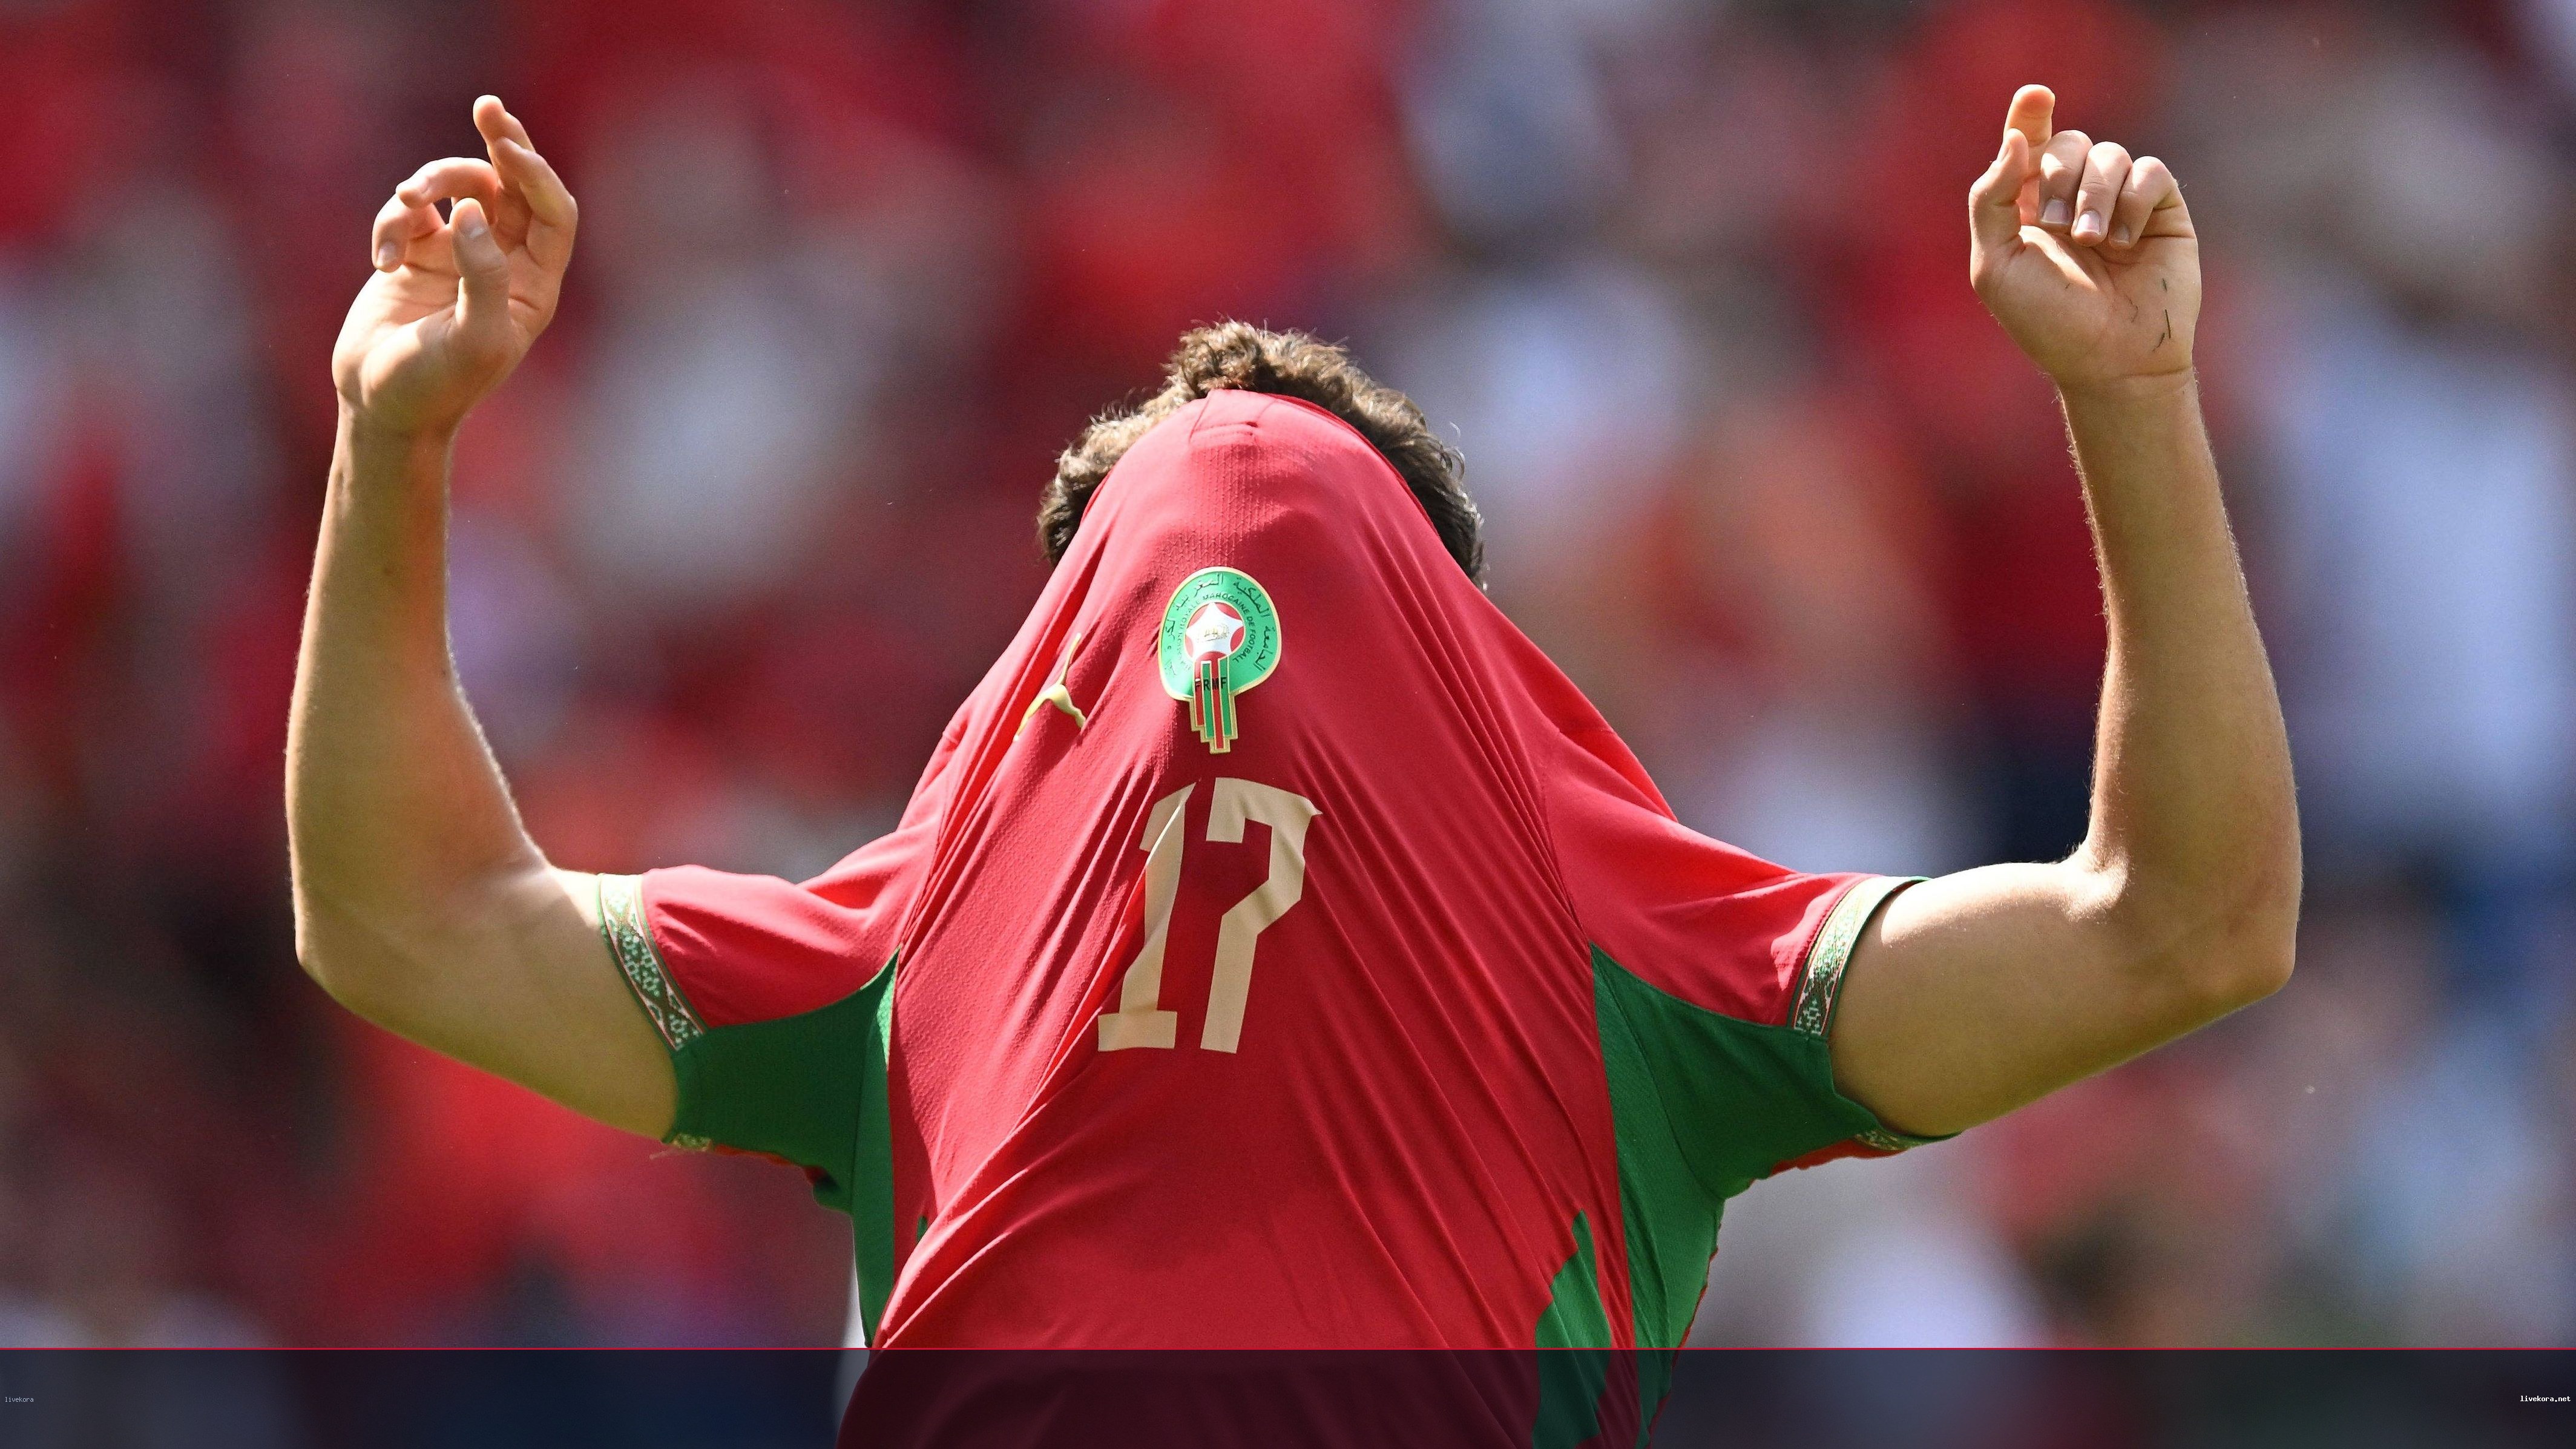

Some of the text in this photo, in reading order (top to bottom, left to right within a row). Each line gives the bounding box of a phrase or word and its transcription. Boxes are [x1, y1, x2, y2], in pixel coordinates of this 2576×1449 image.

[1233, 577, 1270, 617] الملكية
[1247, 616, 1255, 627] DE
[1232, 628, 1256, 663] FOOTBALL
[1253, 625, 1275, 671] الجامعة
[1195, 677, 1227, 692] FRMF
[1098, 777, 1322, 1054] 17
